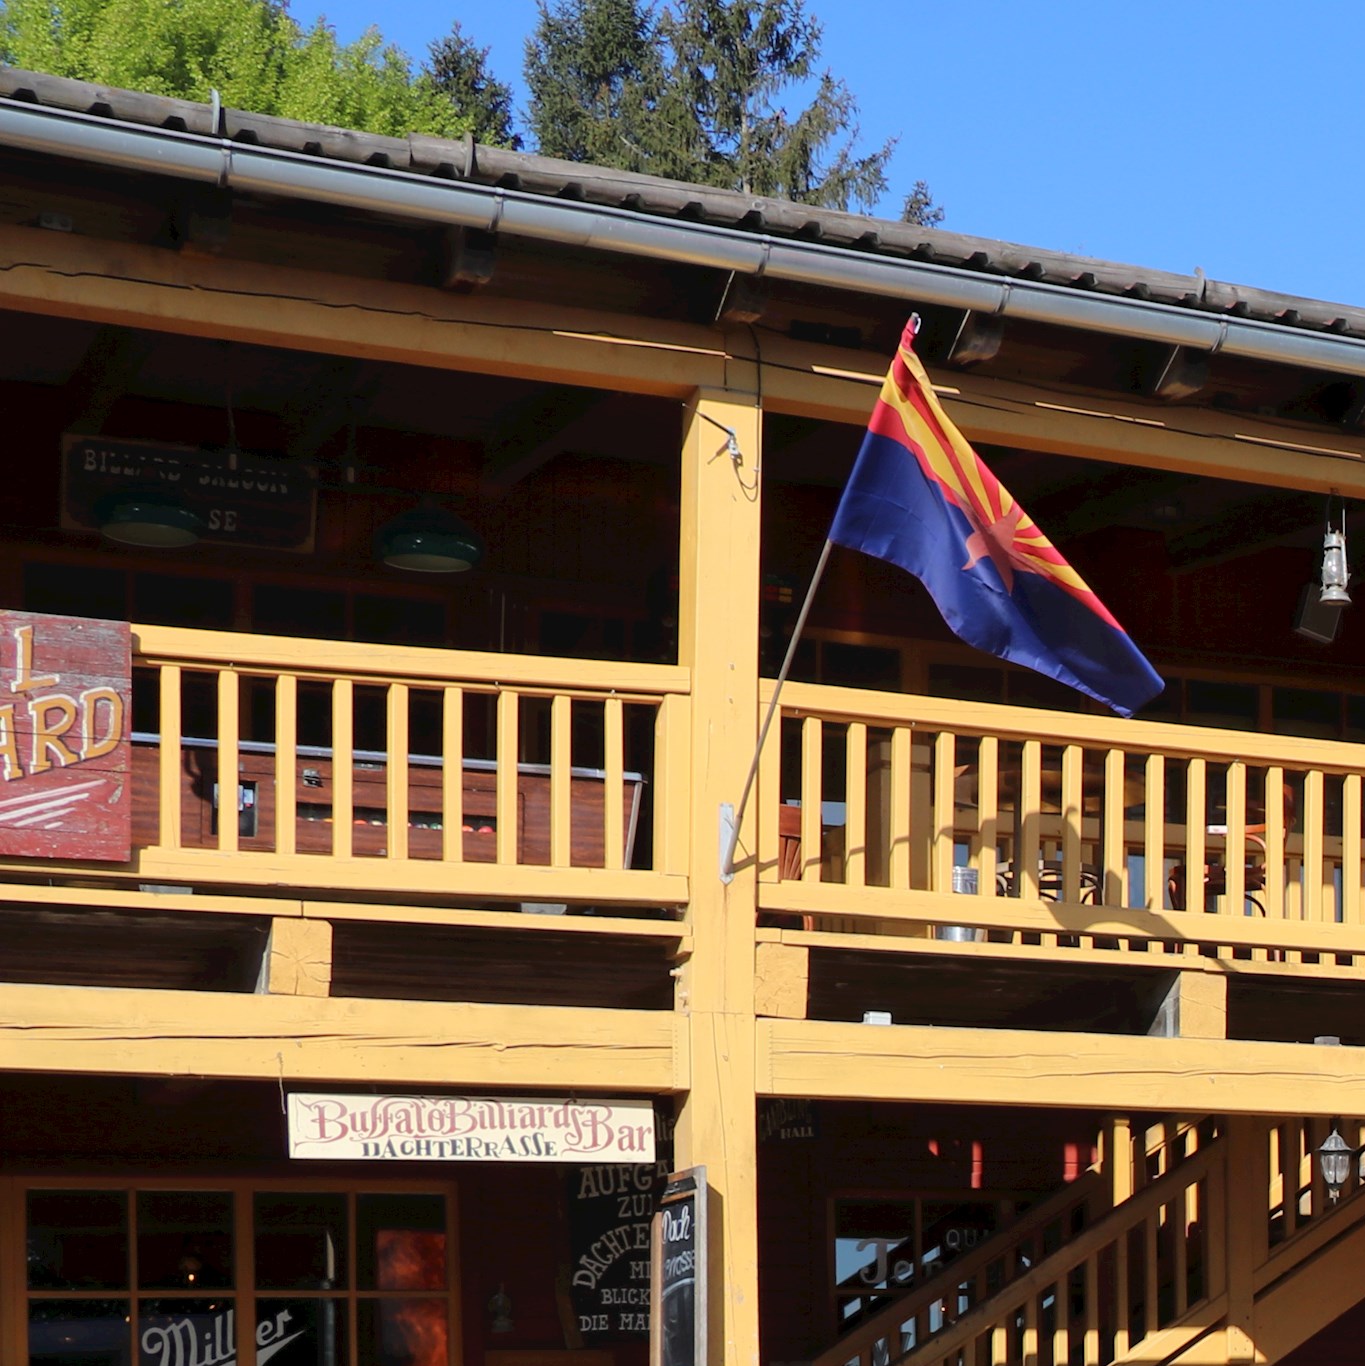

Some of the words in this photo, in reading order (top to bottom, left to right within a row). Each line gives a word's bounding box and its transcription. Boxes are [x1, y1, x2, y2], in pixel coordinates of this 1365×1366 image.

[579, 1103, 653, 1153] Bar
[780, 1126, 814, 1140] HALL
[362, 1132, 558, 1159] DACHTERRASSE
[617, 1195, 651, 1218] ZU
[579, 1314, 609, 1332] DIE
